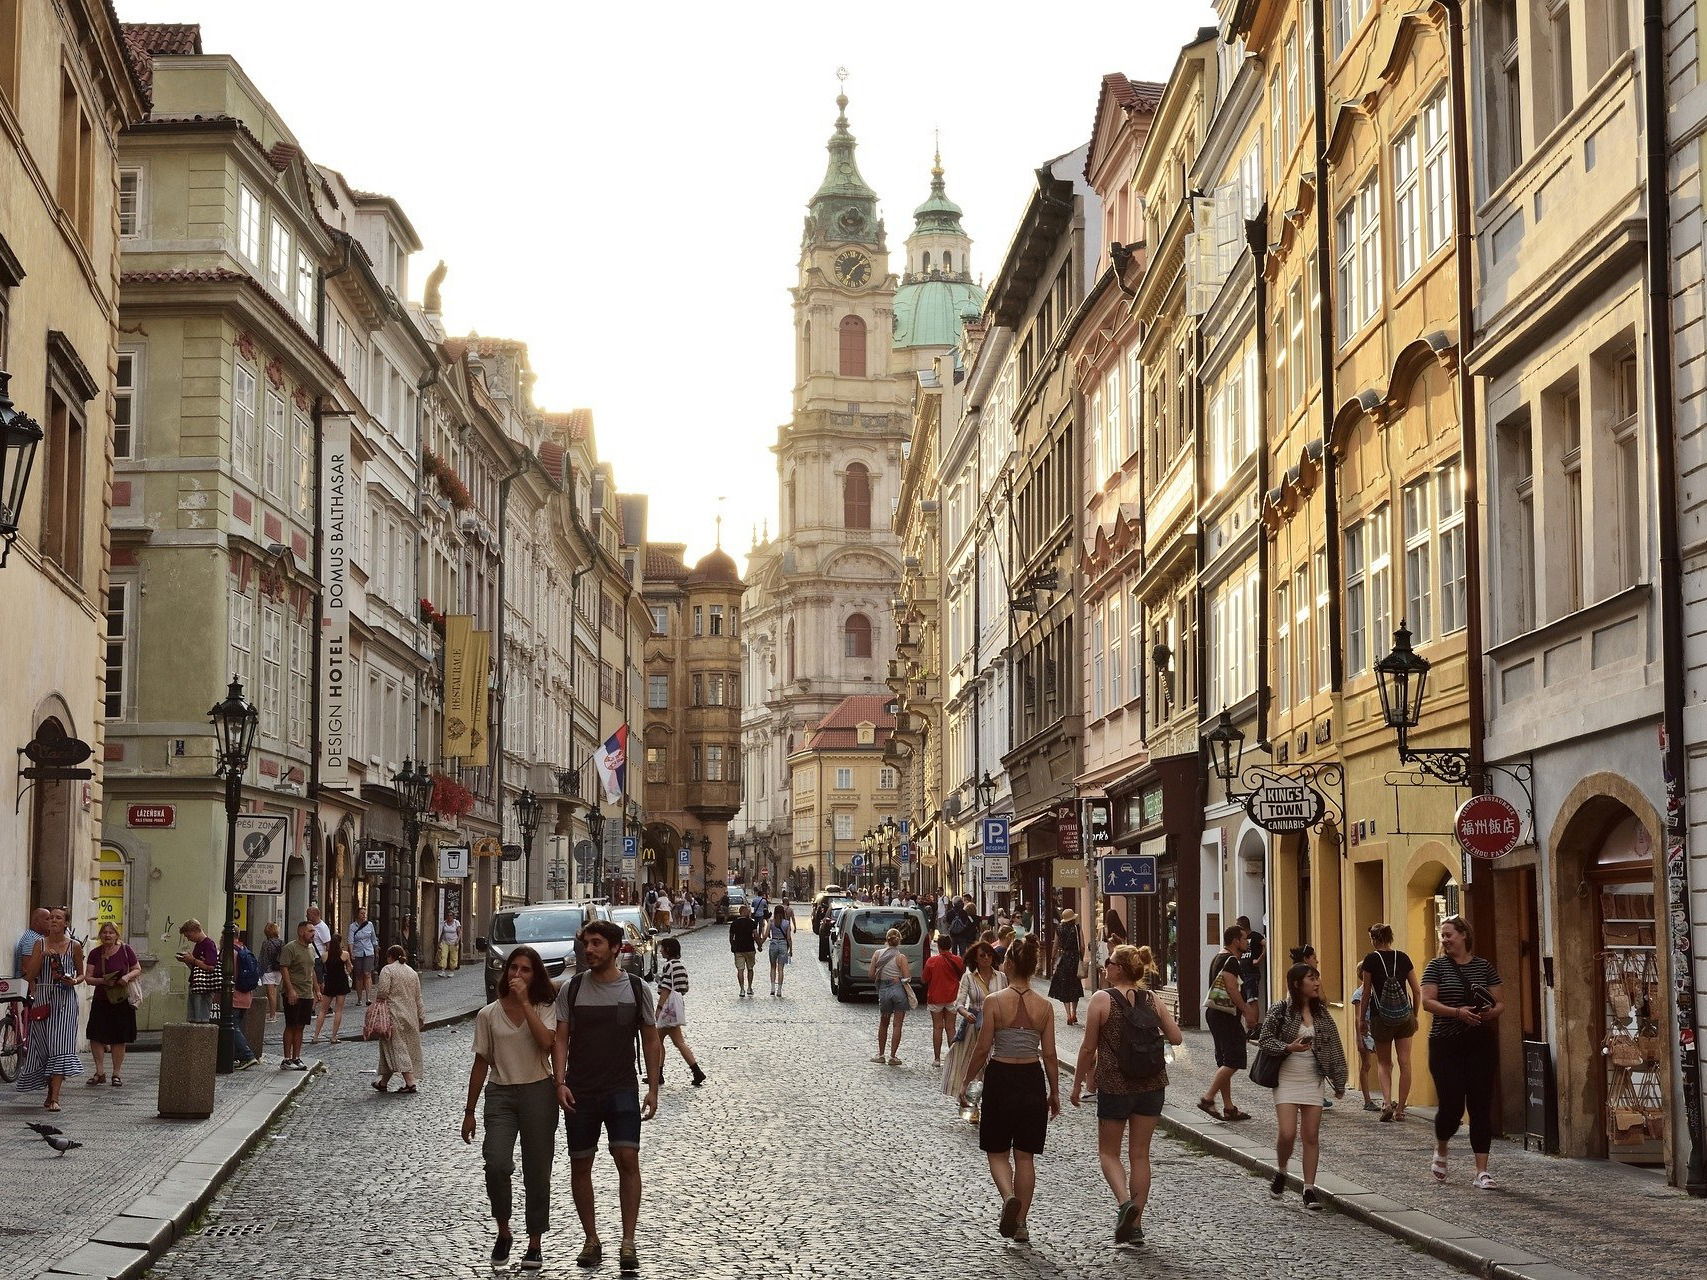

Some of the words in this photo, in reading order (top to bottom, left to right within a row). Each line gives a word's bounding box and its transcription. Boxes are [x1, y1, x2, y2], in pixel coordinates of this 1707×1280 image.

[330, 453, 345, 540] BALTHASAR
[330, 546, 344, 608] DOMUS
[329, 635, 343, 697] HOTEL
[451, 648, 462, 711] RESTAURACE
[328, 705, 342, 768] DESIGN
[1267, 788, 1303, 802] KING'S
[136, 808, 165, 818] LÁZEŇSKÁ
[1267, 803, 1304, 817] TOWN
[988, 822, 1004, 844] P
[1267, 820, 1306, 830] CANNABIS
[1461, 817, 1516, 836] 福州飯店
[624, 839, 634, 852] P
[1462, 837, 1471, 848] FU
[1470, 846, 1489, 857] ZHOU
[1490, 849, 1505, 857] FAN
[1504, 835, 1518, 851] DIAN
[1059, 867, 1080, 875] CAFÉ
